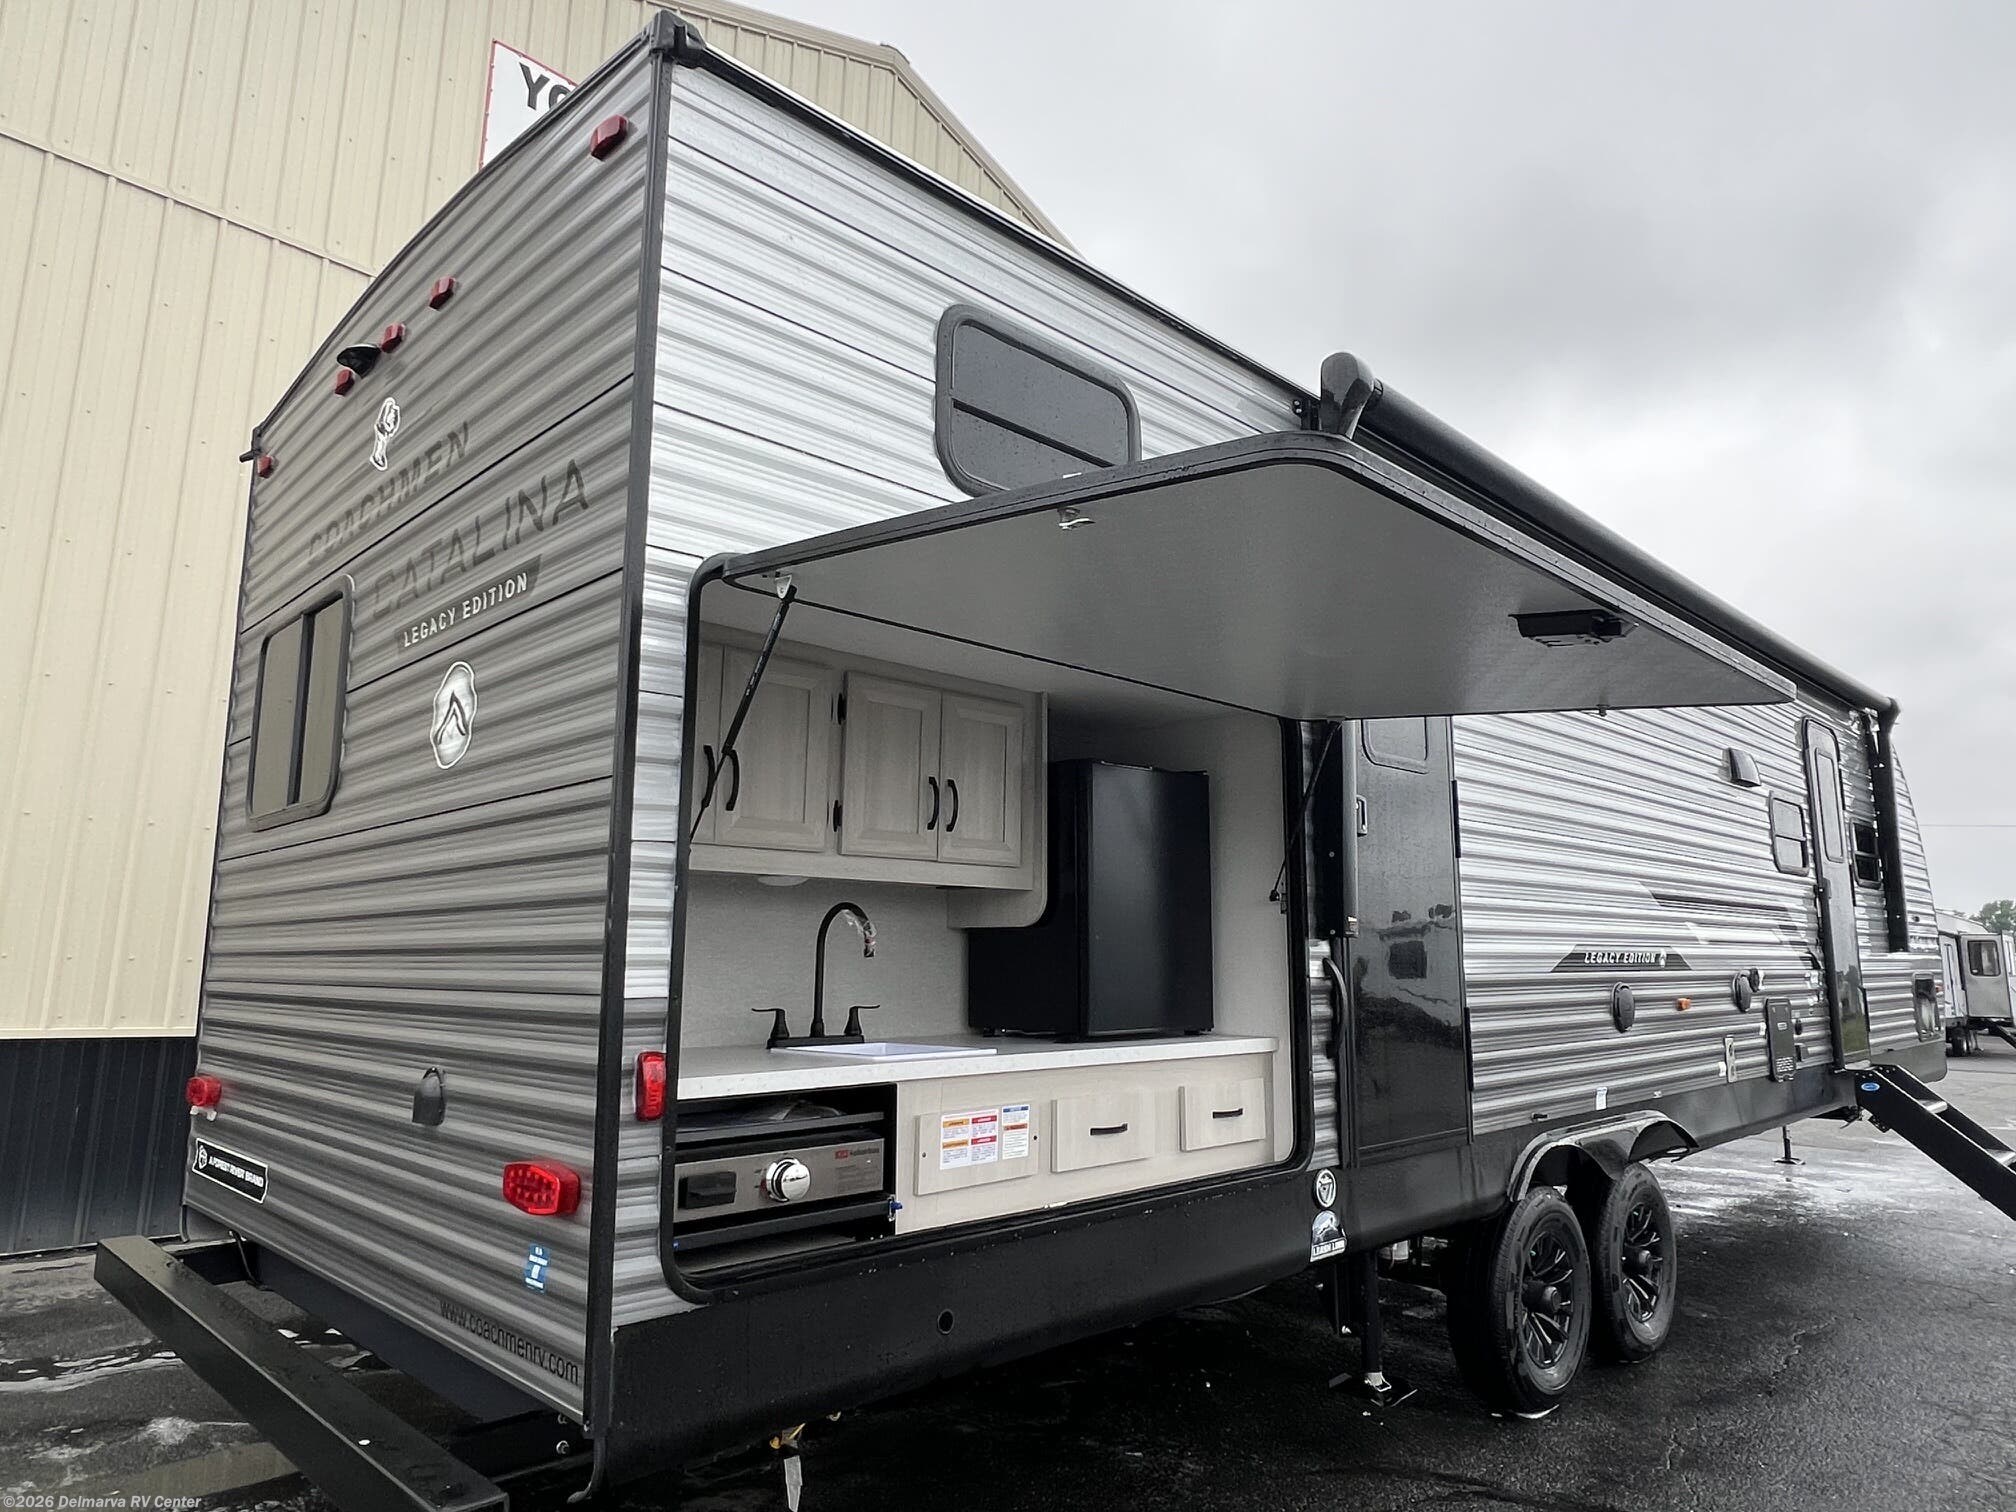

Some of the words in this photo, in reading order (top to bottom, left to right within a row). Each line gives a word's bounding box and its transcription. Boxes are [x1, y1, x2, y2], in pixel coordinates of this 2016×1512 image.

[308, 421, 469, 567] COACHMEN
[373, 459, 589, 620] CATALINA
[403, 607, 457, 648] LEGACY
[462, 572, 528, 619] EDITION
[1584, 951, 1621, 964] LEGACY
[1623, 951, 1657, 964] EDITION
